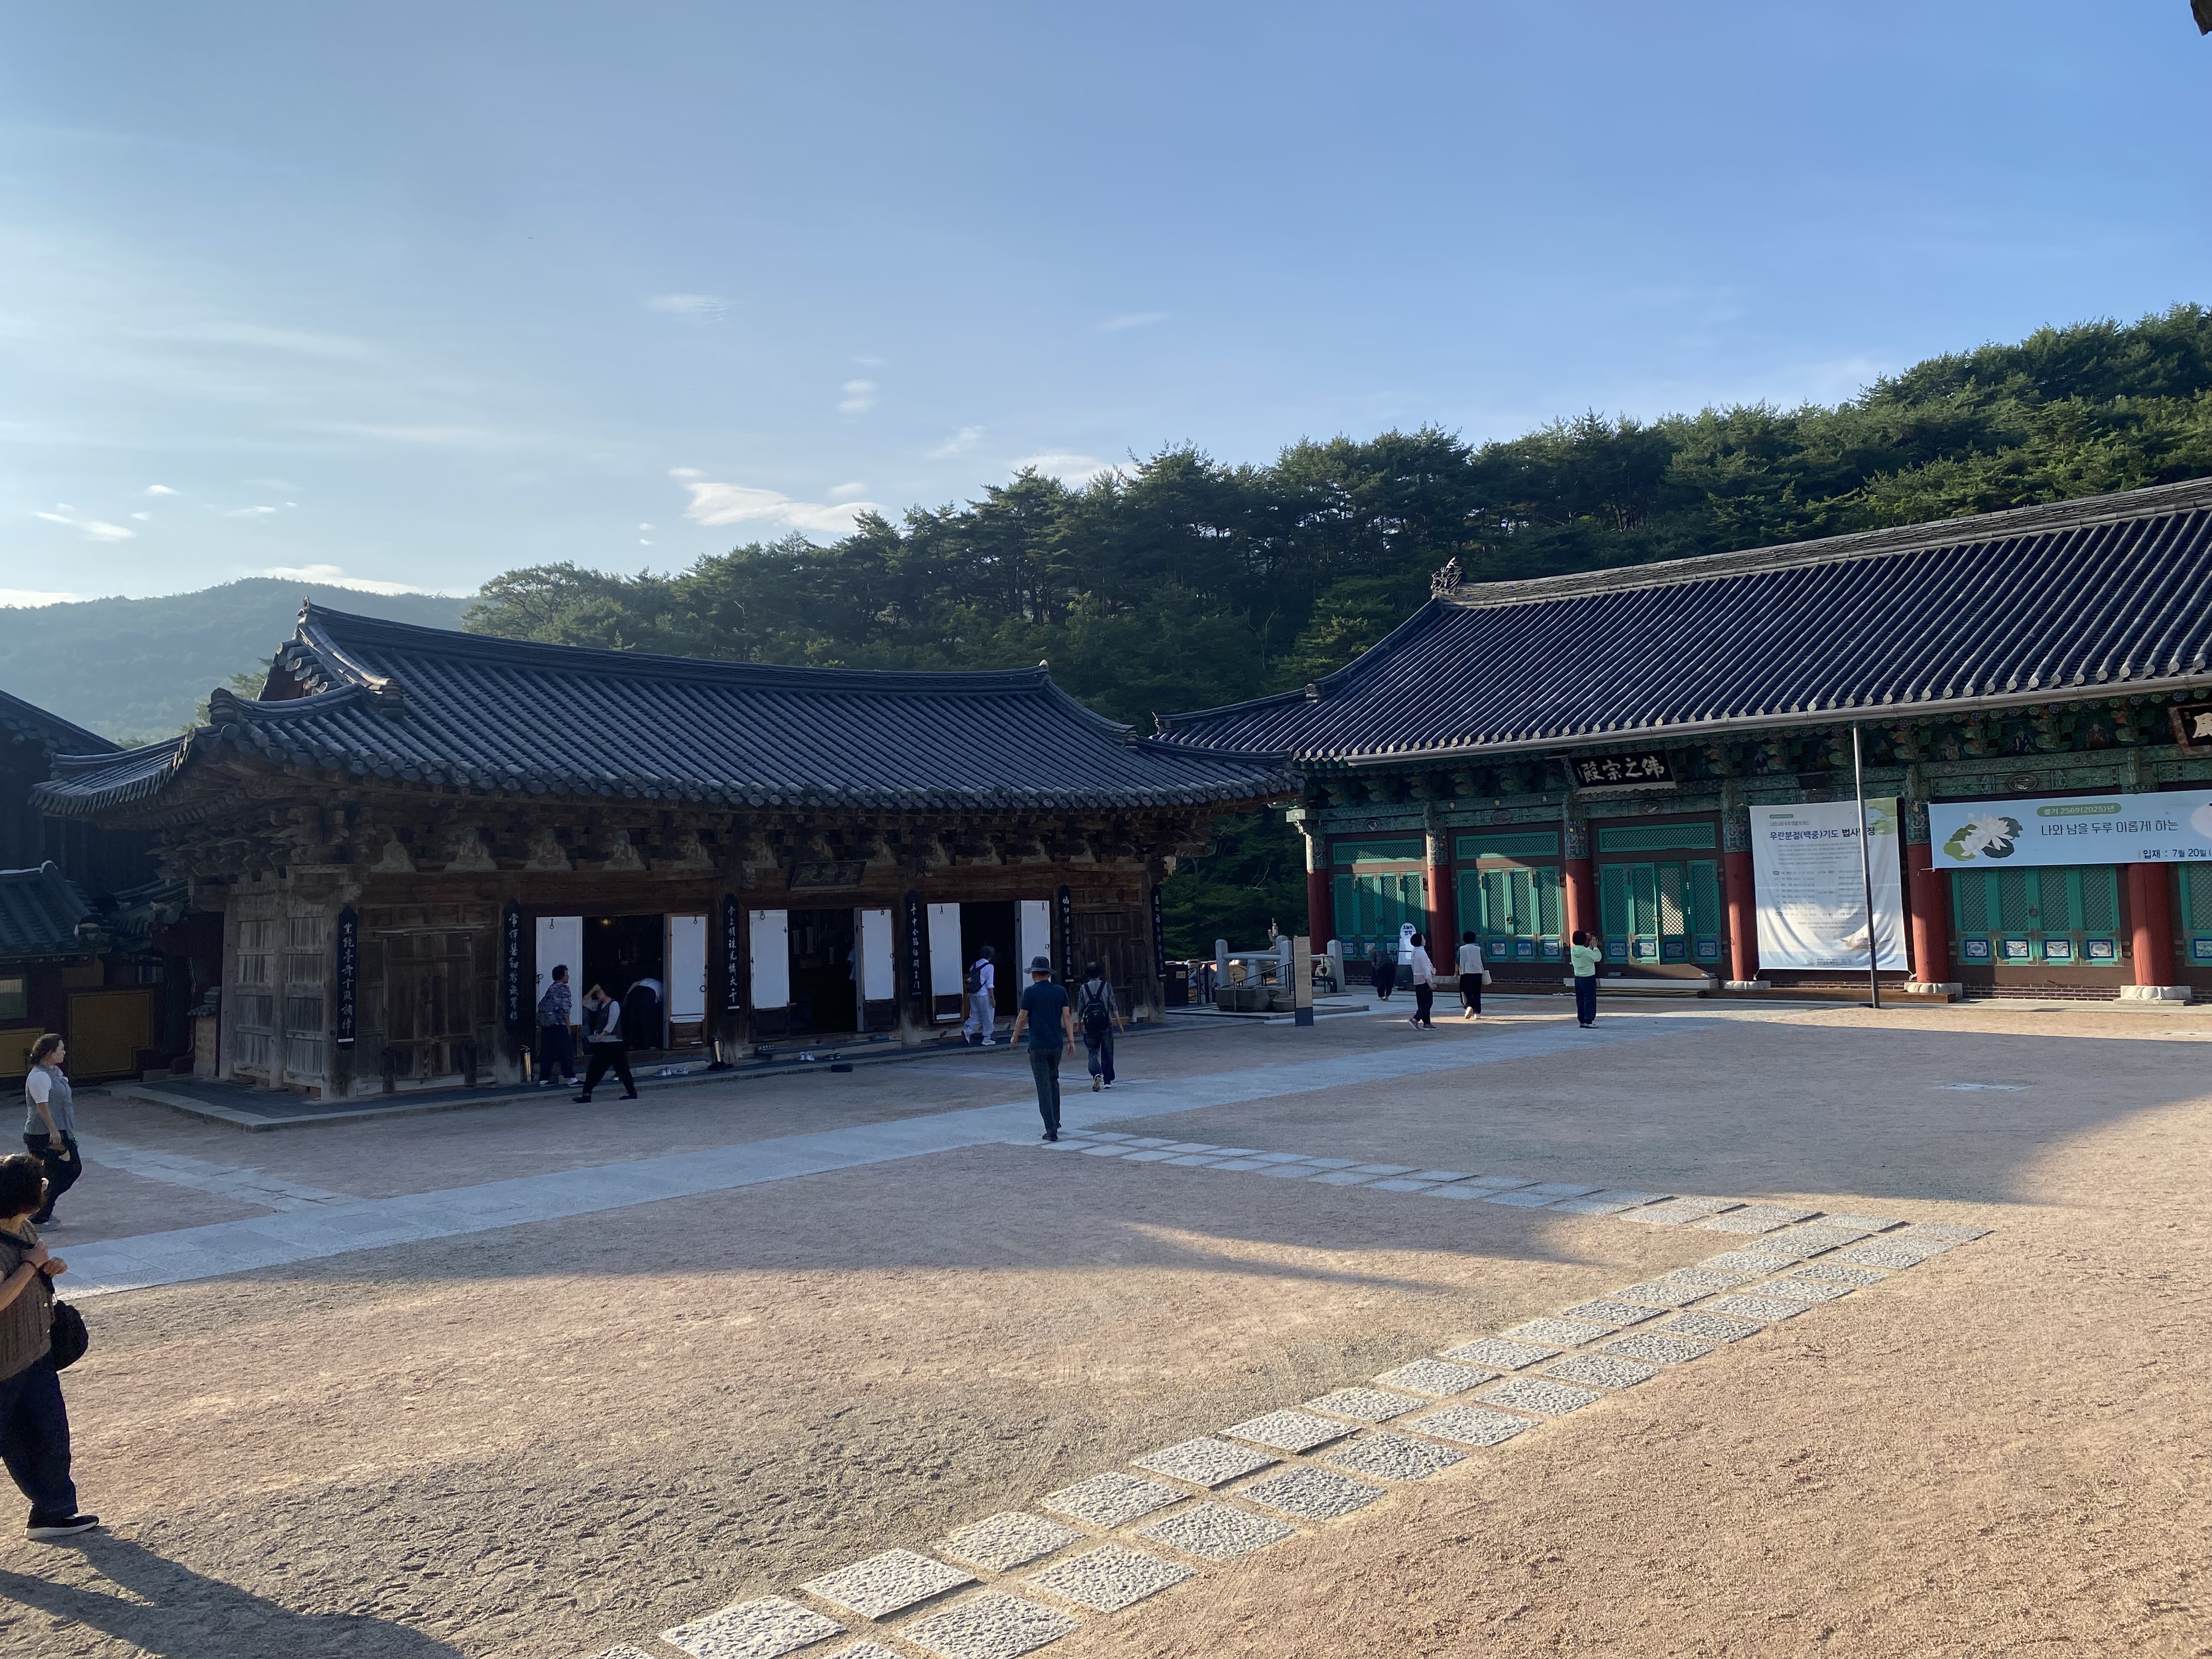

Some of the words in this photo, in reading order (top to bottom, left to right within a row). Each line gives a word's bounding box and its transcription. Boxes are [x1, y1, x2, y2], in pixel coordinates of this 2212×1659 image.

[2060, 805, 2115, 815] 2569(2025)년
[1769, 830, 1839, 840] 우란분절(백중)기도
[1842, 827, 1875, 837] 법사정
[2041, 824, 2063, 836] 나와
[2067, 823, 2089, 835] 남을
[2091, 822, 2113, 834] 두루
[2117, 820, 2151, 833] 이롭게
[2155, 820, 2179, 832] 하는
[2143, 849, 2160, 859] 입재
[2172, 849, 2185, 858] 7월
[2188, 848, 2207, 857] 20일
